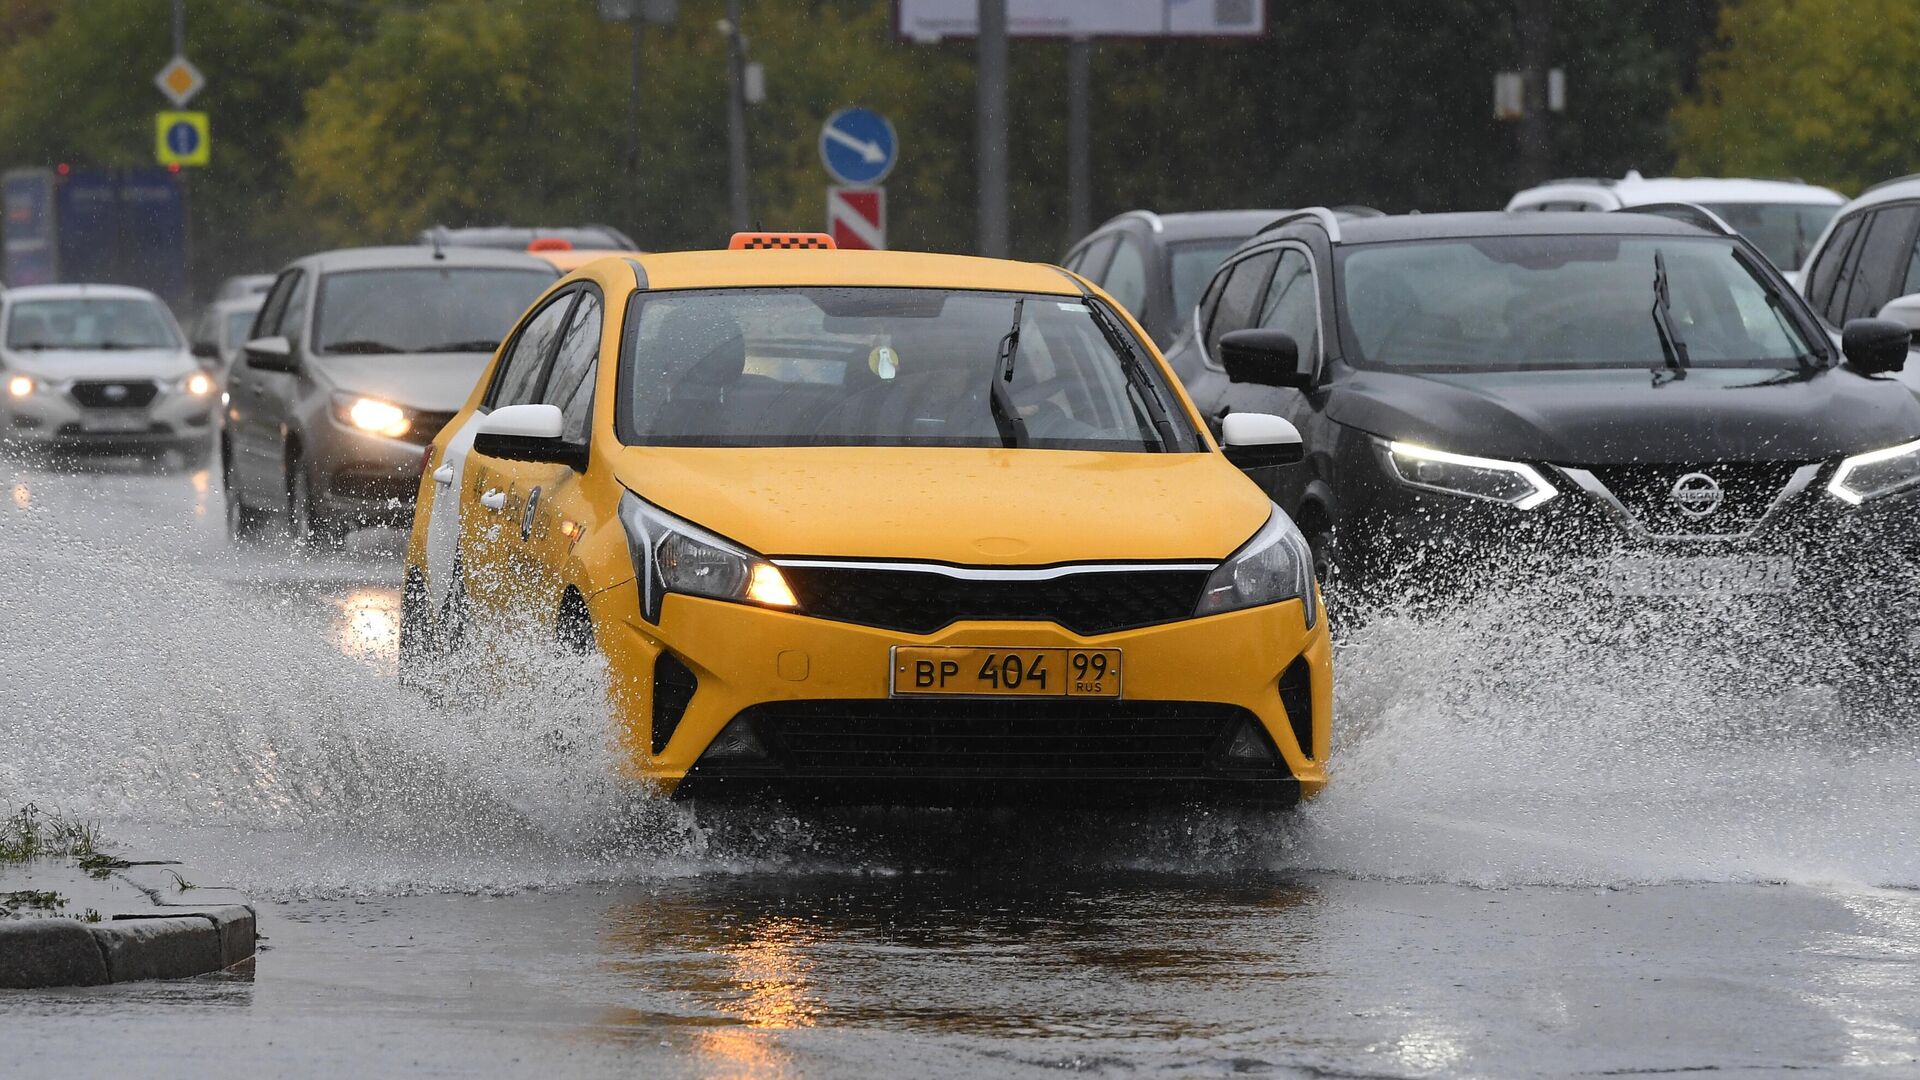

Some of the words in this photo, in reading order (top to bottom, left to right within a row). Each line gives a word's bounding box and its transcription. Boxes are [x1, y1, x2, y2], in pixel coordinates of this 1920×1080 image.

[978, 653, 1047, 690] 404
[1072, 653, 1107, 681] 99
[1076, 683, 1102, 692] RUS
